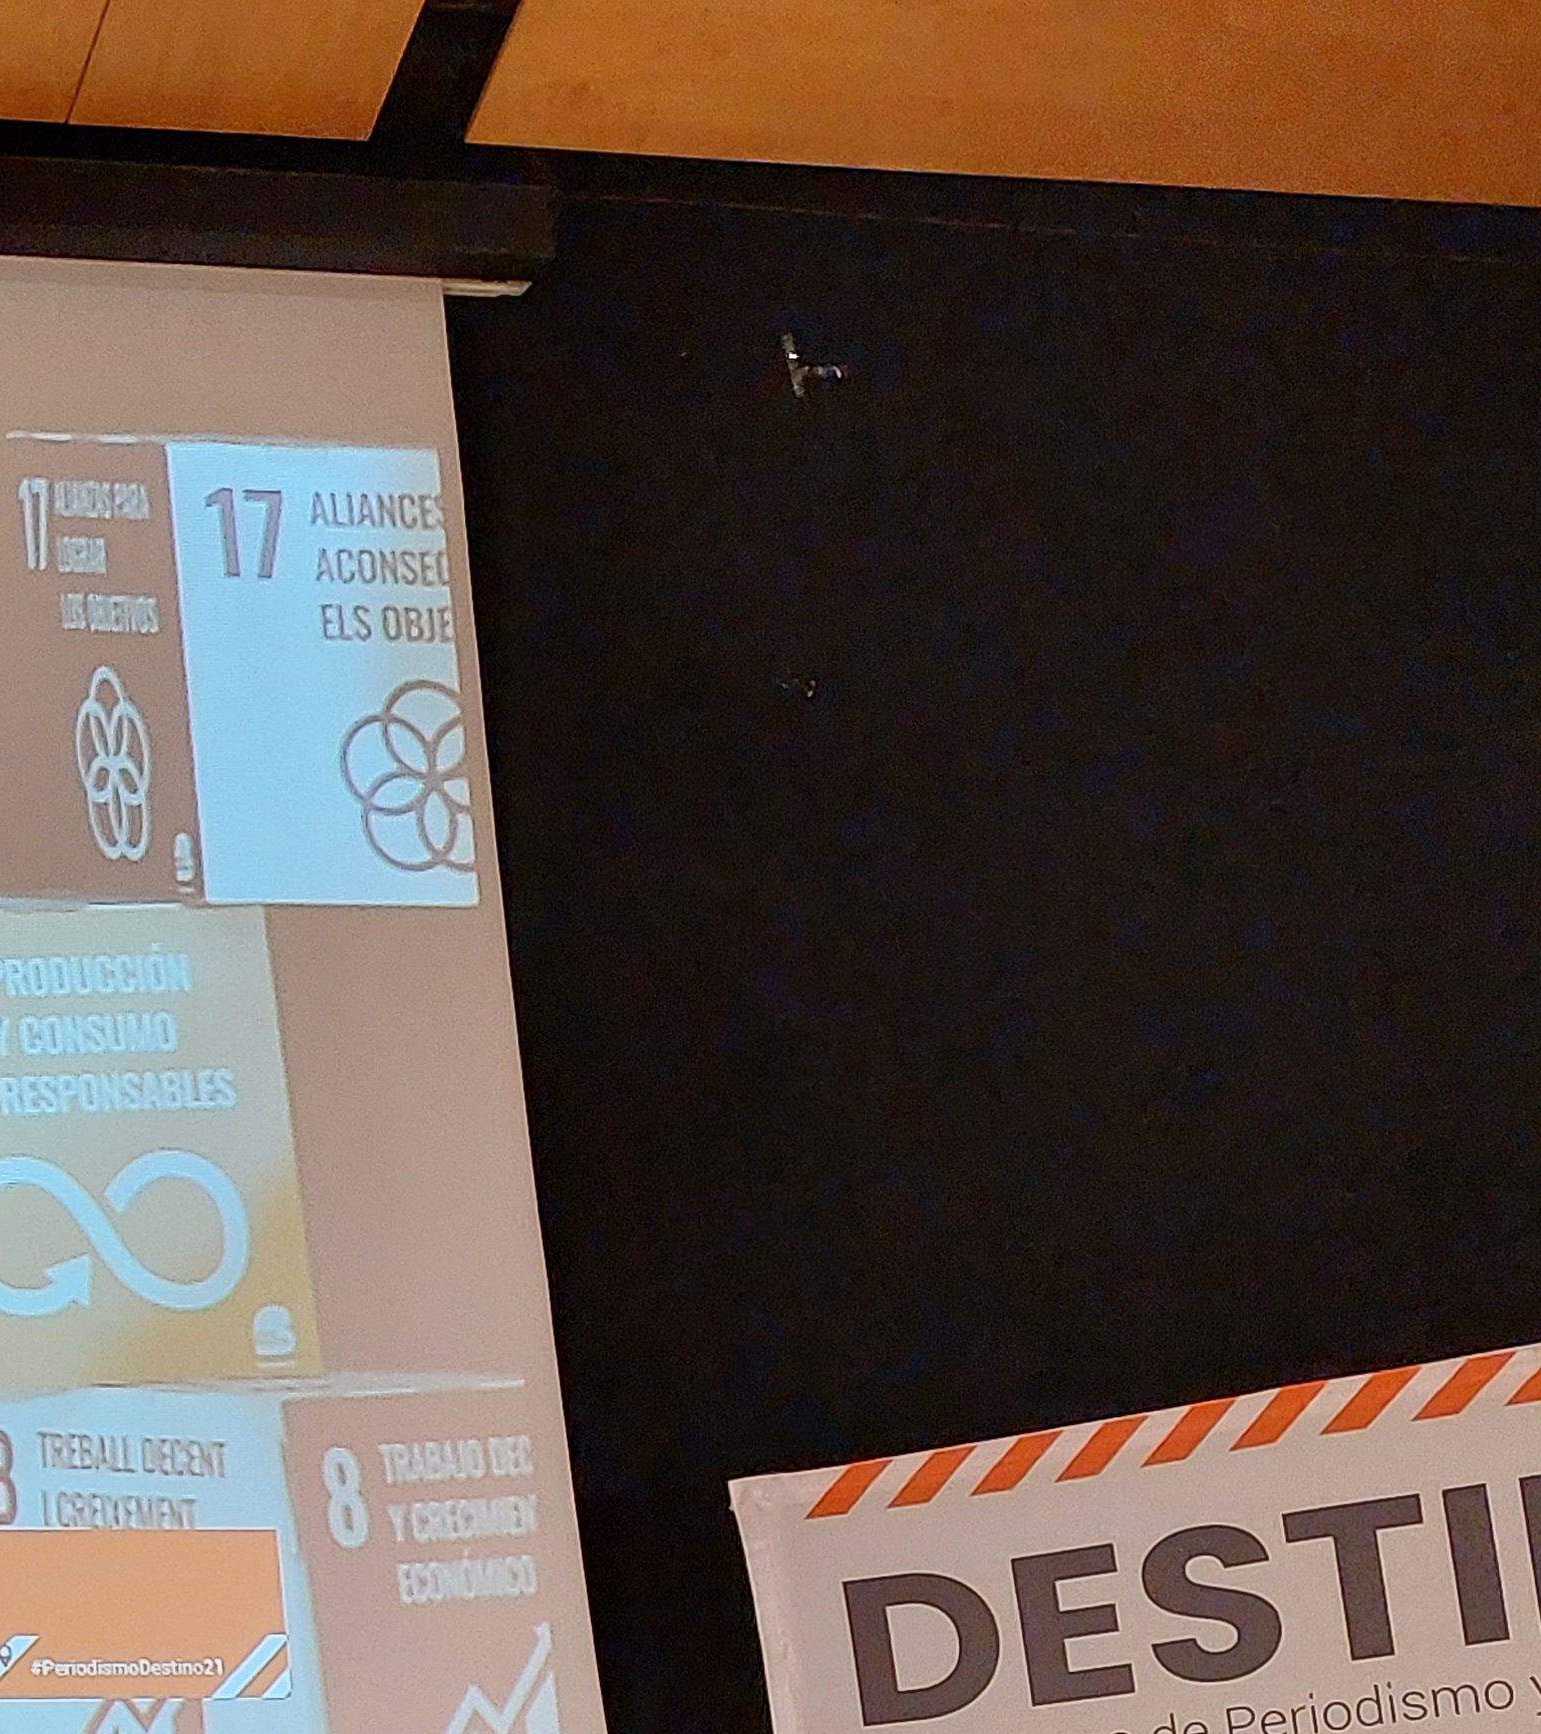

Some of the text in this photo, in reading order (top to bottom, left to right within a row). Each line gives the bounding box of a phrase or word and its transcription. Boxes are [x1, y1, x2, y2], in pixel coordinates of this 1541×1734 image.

[205, 487, 283, 578] 17
[309, 491, 443, 530] ALIANCES
[322, 602, 453, 644] ELS OBJE
[18, 1010, 179, 1056] CONSUMO
[37, 1430, 226, 1478] TREBALL DECENT
[377, 1438, 486, 1484] TRABAJO
[322, 1447, 369, 1549] 8
[397, 1547, 539, 1604] ECONÓMICO
[842, 1475, 1541, 1728] DESTI
[30, 1657, 225, 1677] #PeriodismoDestino21
